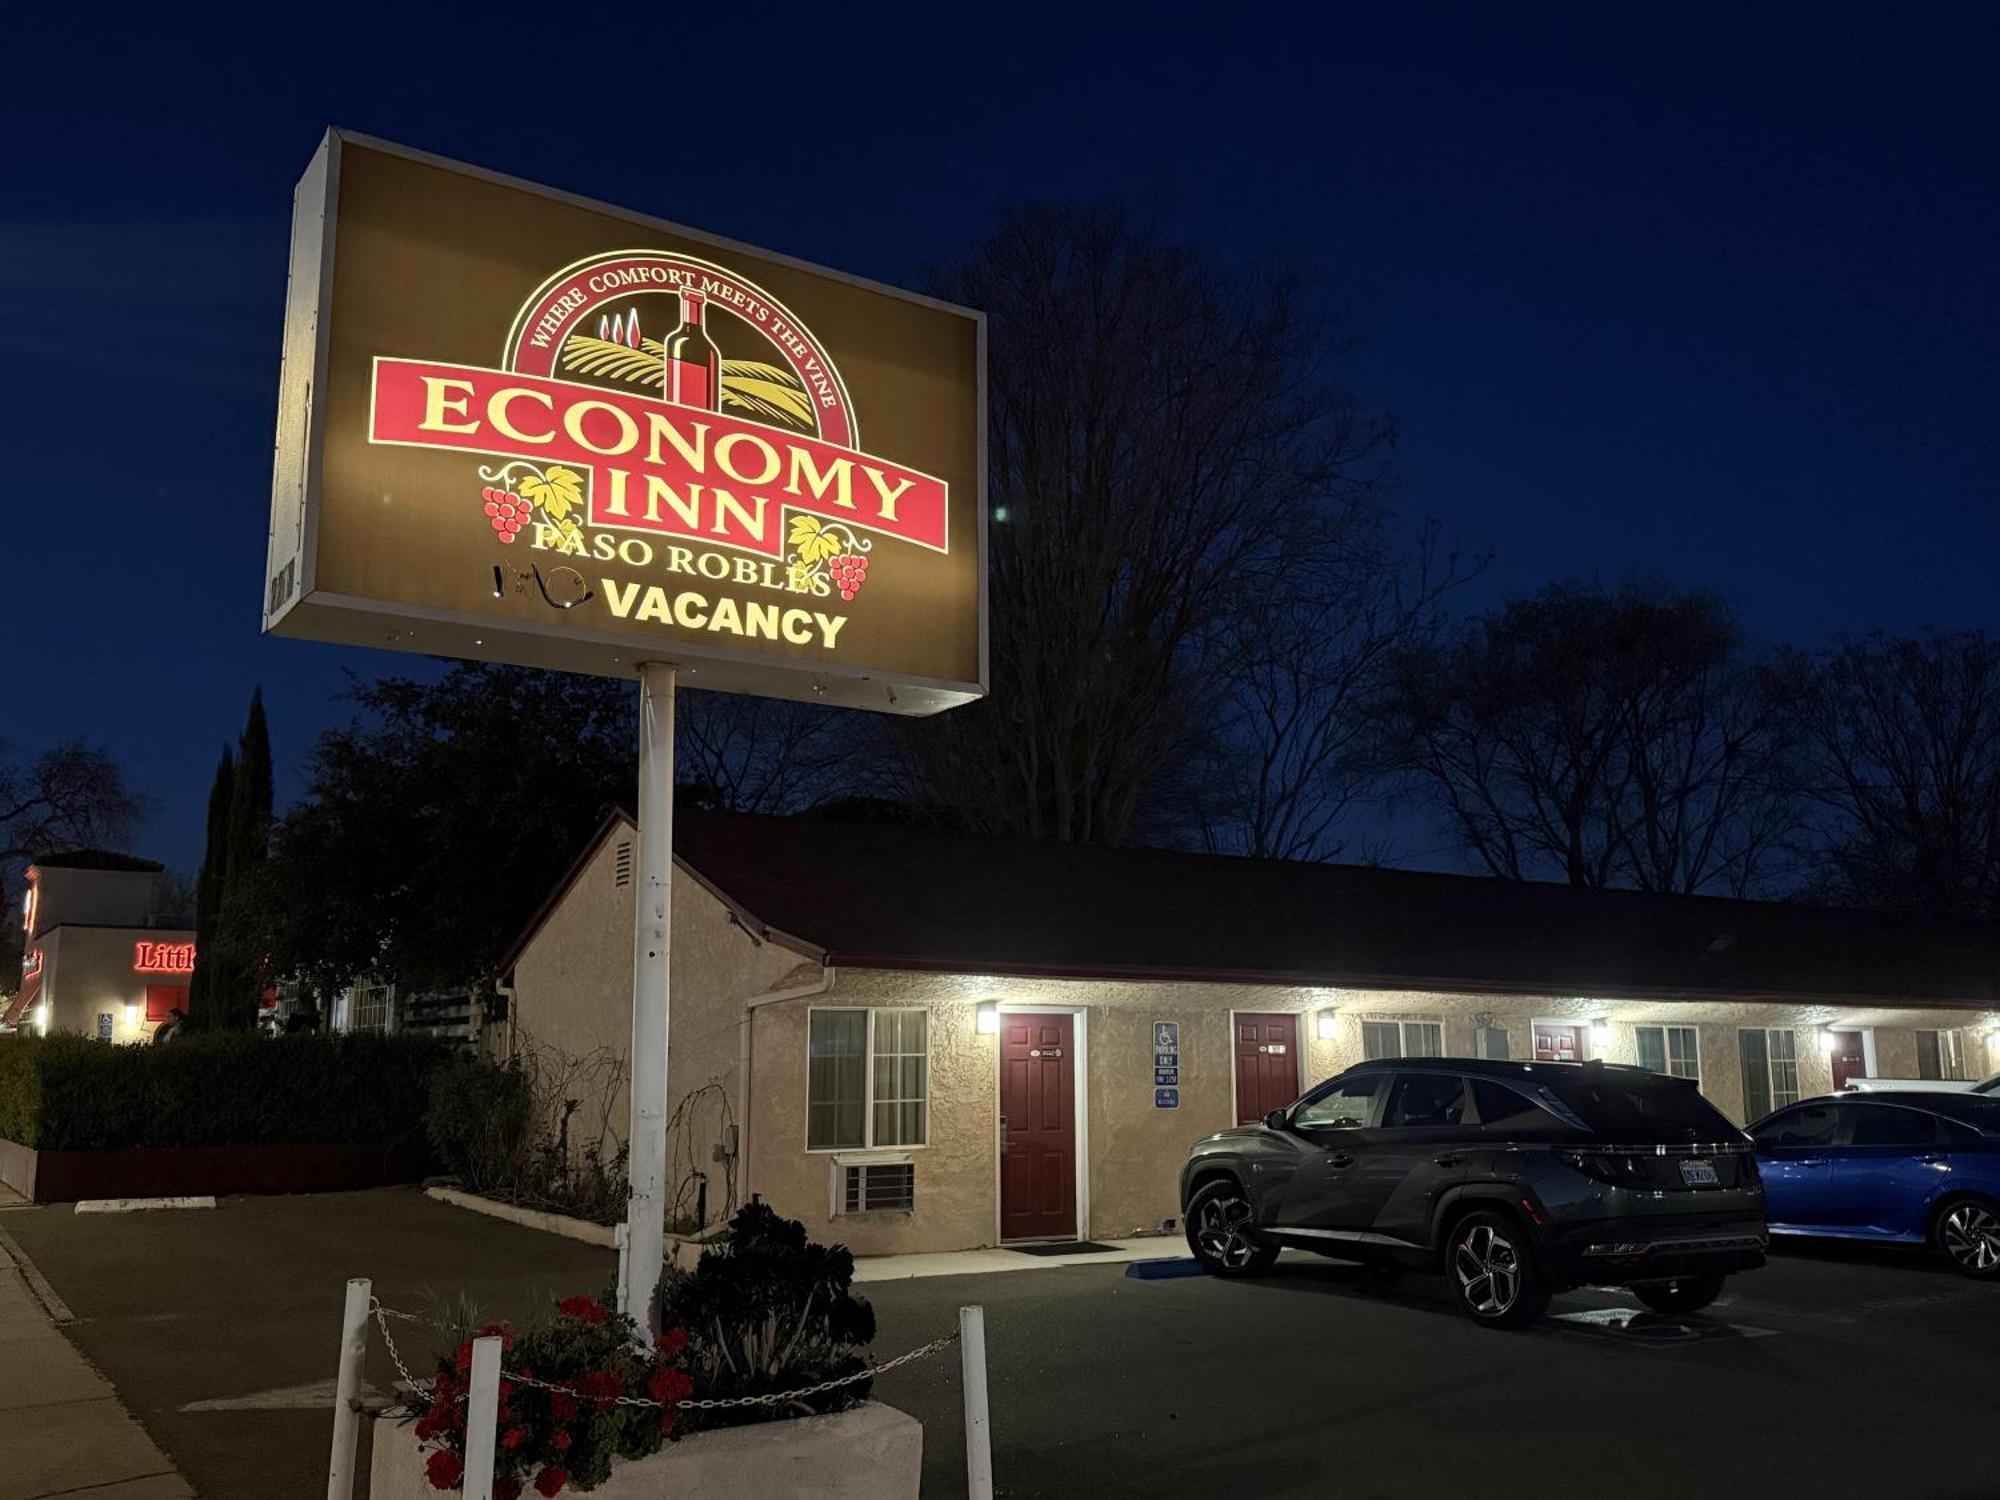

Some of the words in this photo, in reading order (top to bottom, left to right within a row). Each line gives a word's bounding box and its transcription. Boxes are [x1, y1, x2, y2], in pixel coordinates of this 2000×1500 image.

[530, 287, 588, 350] WHERE
[588, 266, 696, 293] COMFORT
[702, 276, 769, 322] MEETS
[771, 317, 809, 360] THE
[805, 357, 836, 409] VINE
[418, 376, 916, 522] ECONOMY
[605, 469, 770, 542] INN
[531, 522, 653, 566] PASO
[667, 546, 832, 597] ROBLES
[600, 578, 848, 649] VACANCY
[136, 943, 197, 970] Littl
